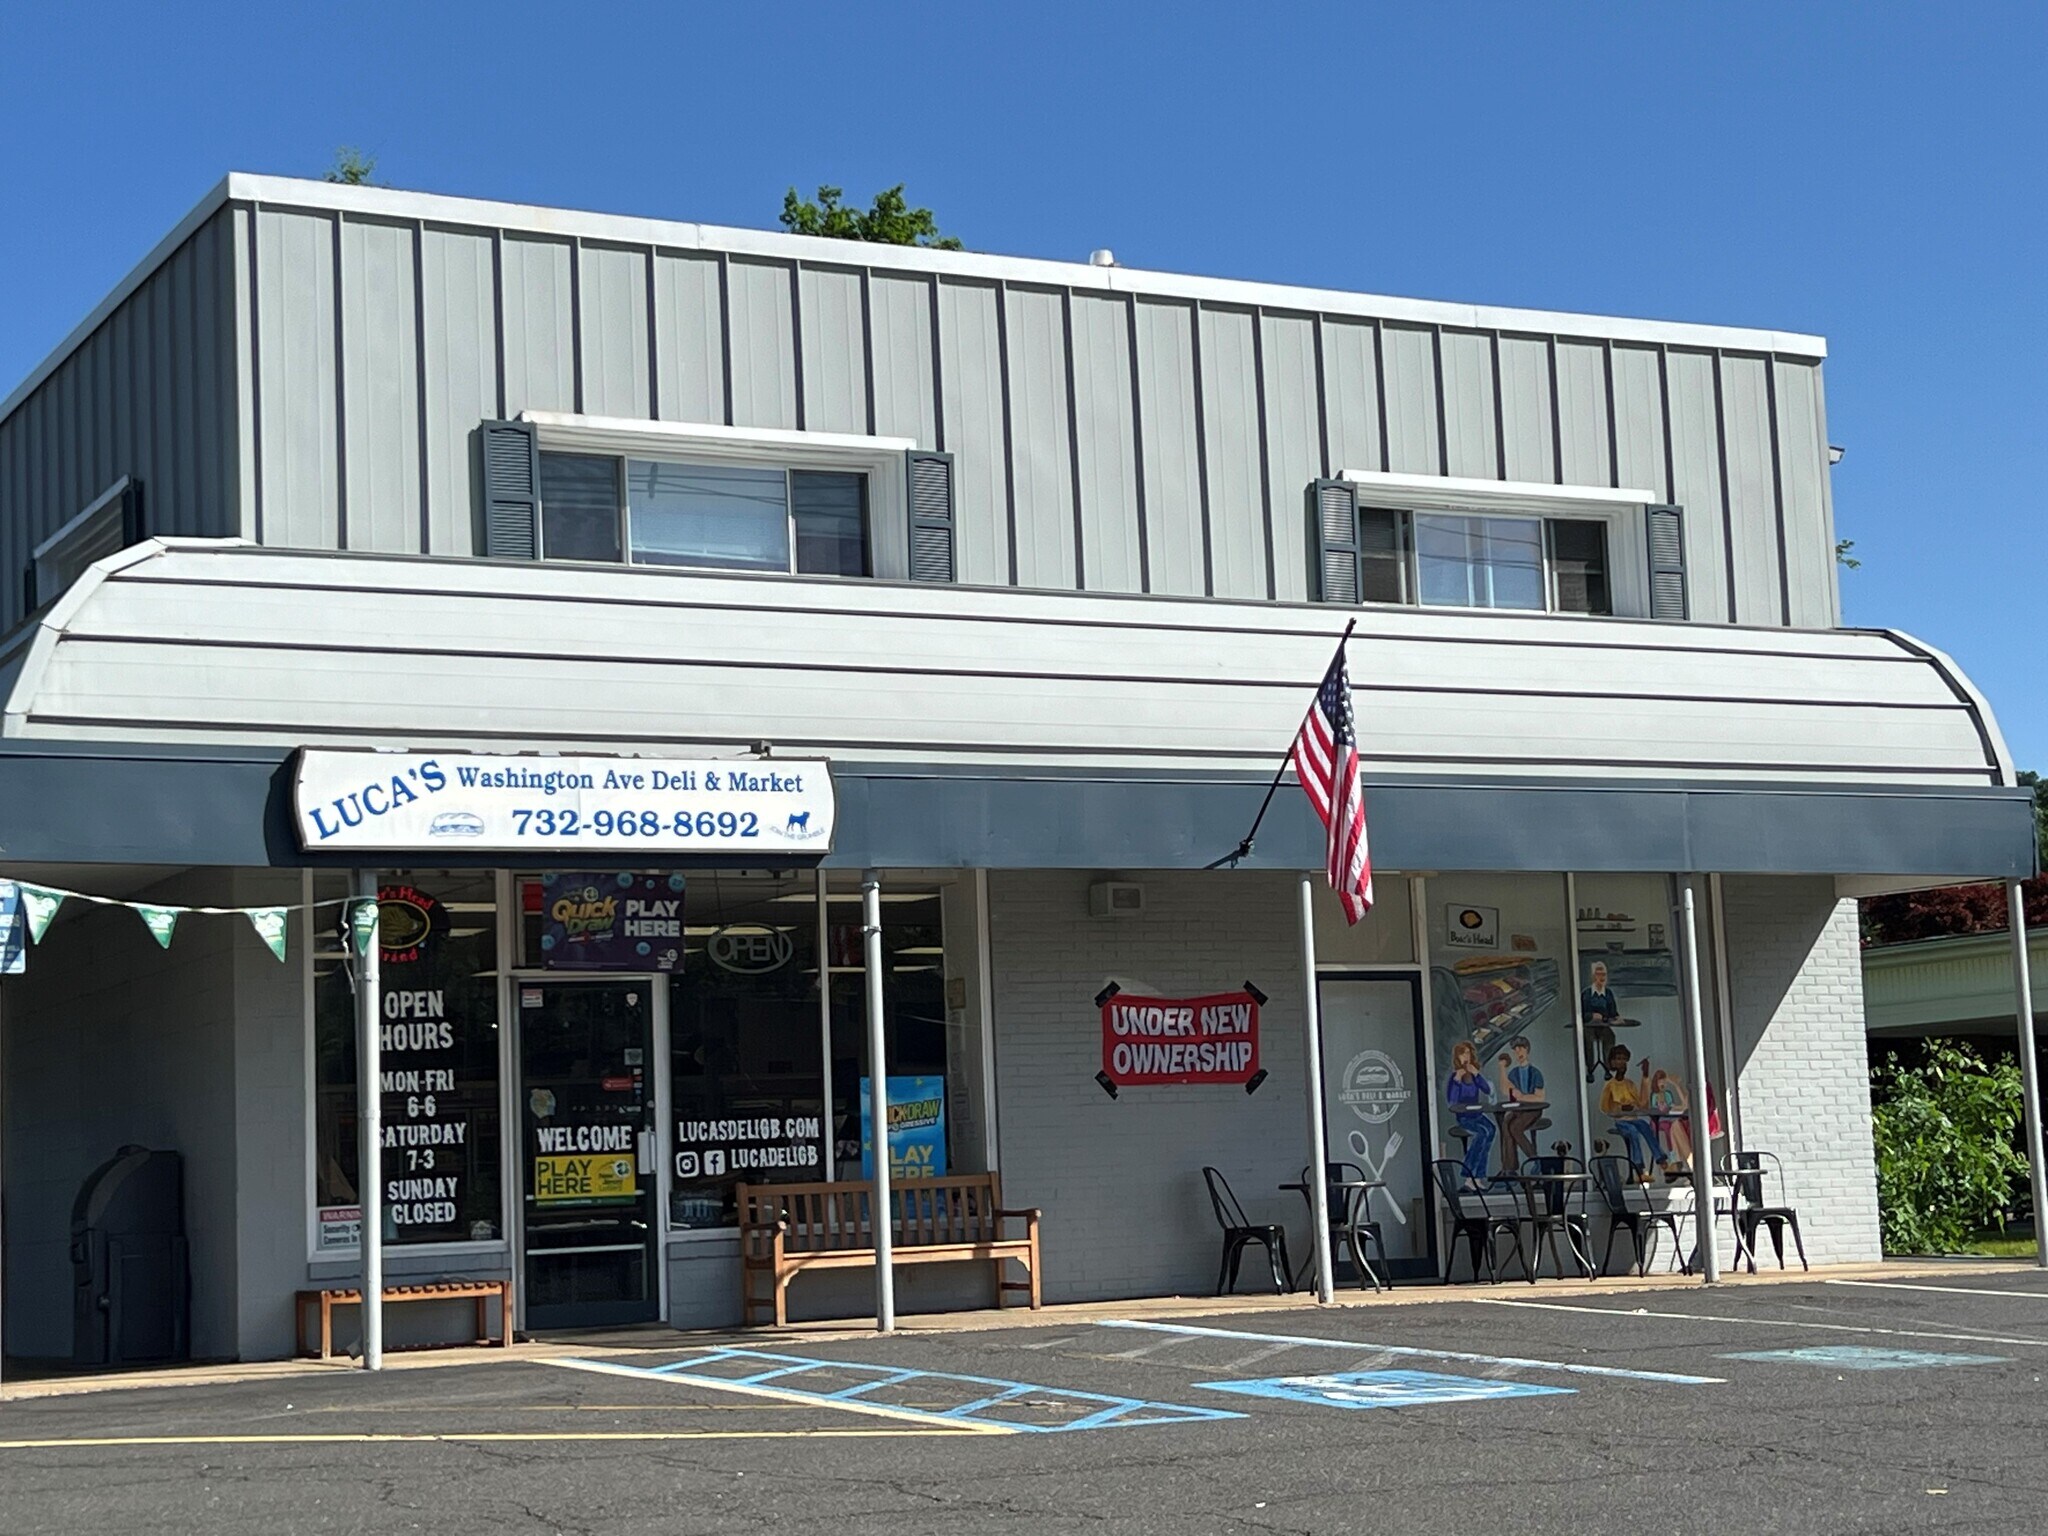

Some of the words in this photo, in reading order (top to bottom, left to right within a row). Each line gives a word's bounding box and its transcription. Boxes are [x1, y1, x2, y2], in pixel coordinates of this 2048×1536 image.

[457, 767, 595, 795] Washington
[603, 769, 645, 790] Ave
[652, 770, 697, 791] Deli
[705, 771, 721, 791] &
[729, 771, 804, 793] Market
[309, 760, 447, 840] LUCA'S
[512, 809, 760, 838] 732-968-8692
[626, 899, 681, 917] PLAY
[624, 920, 681, 937] HERE
[381, 946, 418, 962] rand
[714, 934, 786, 965] OPEN
[385, 990, 444, 1019] OPEN
[1111, 1004, 1196, 1036] UNDER
[1201, 1003, 1252, 1036] NEW
[379, 1022, 454, 1051] HOURS
[1112, 1042, 1252, 1075] OWNERSHIP
[379, 1069, 455, 1093] MON-FRI
[407, 1095, 437, 1117] 6-6
[536, 1125, 632, 1152] WELCOME
[679, 1117, 820, 1142] LUCASDELIGB.COM
[406, 1149, 435, 1171] 7-3
[731, 1145, 818, 1169] LUCADELIGB
[890, 1145, 934, 1165] LAY
[537, 1160, 593, 1178] PLAY
[891, 1166, 935, 1179] ERE
[387, 1177, 458, 1200] SUNDAY
[538, 1177, 593, 1195] HERE
[322, 1210, 362, 1221] WARNIN
[391, 1202, 457, 1224] CLOSED
